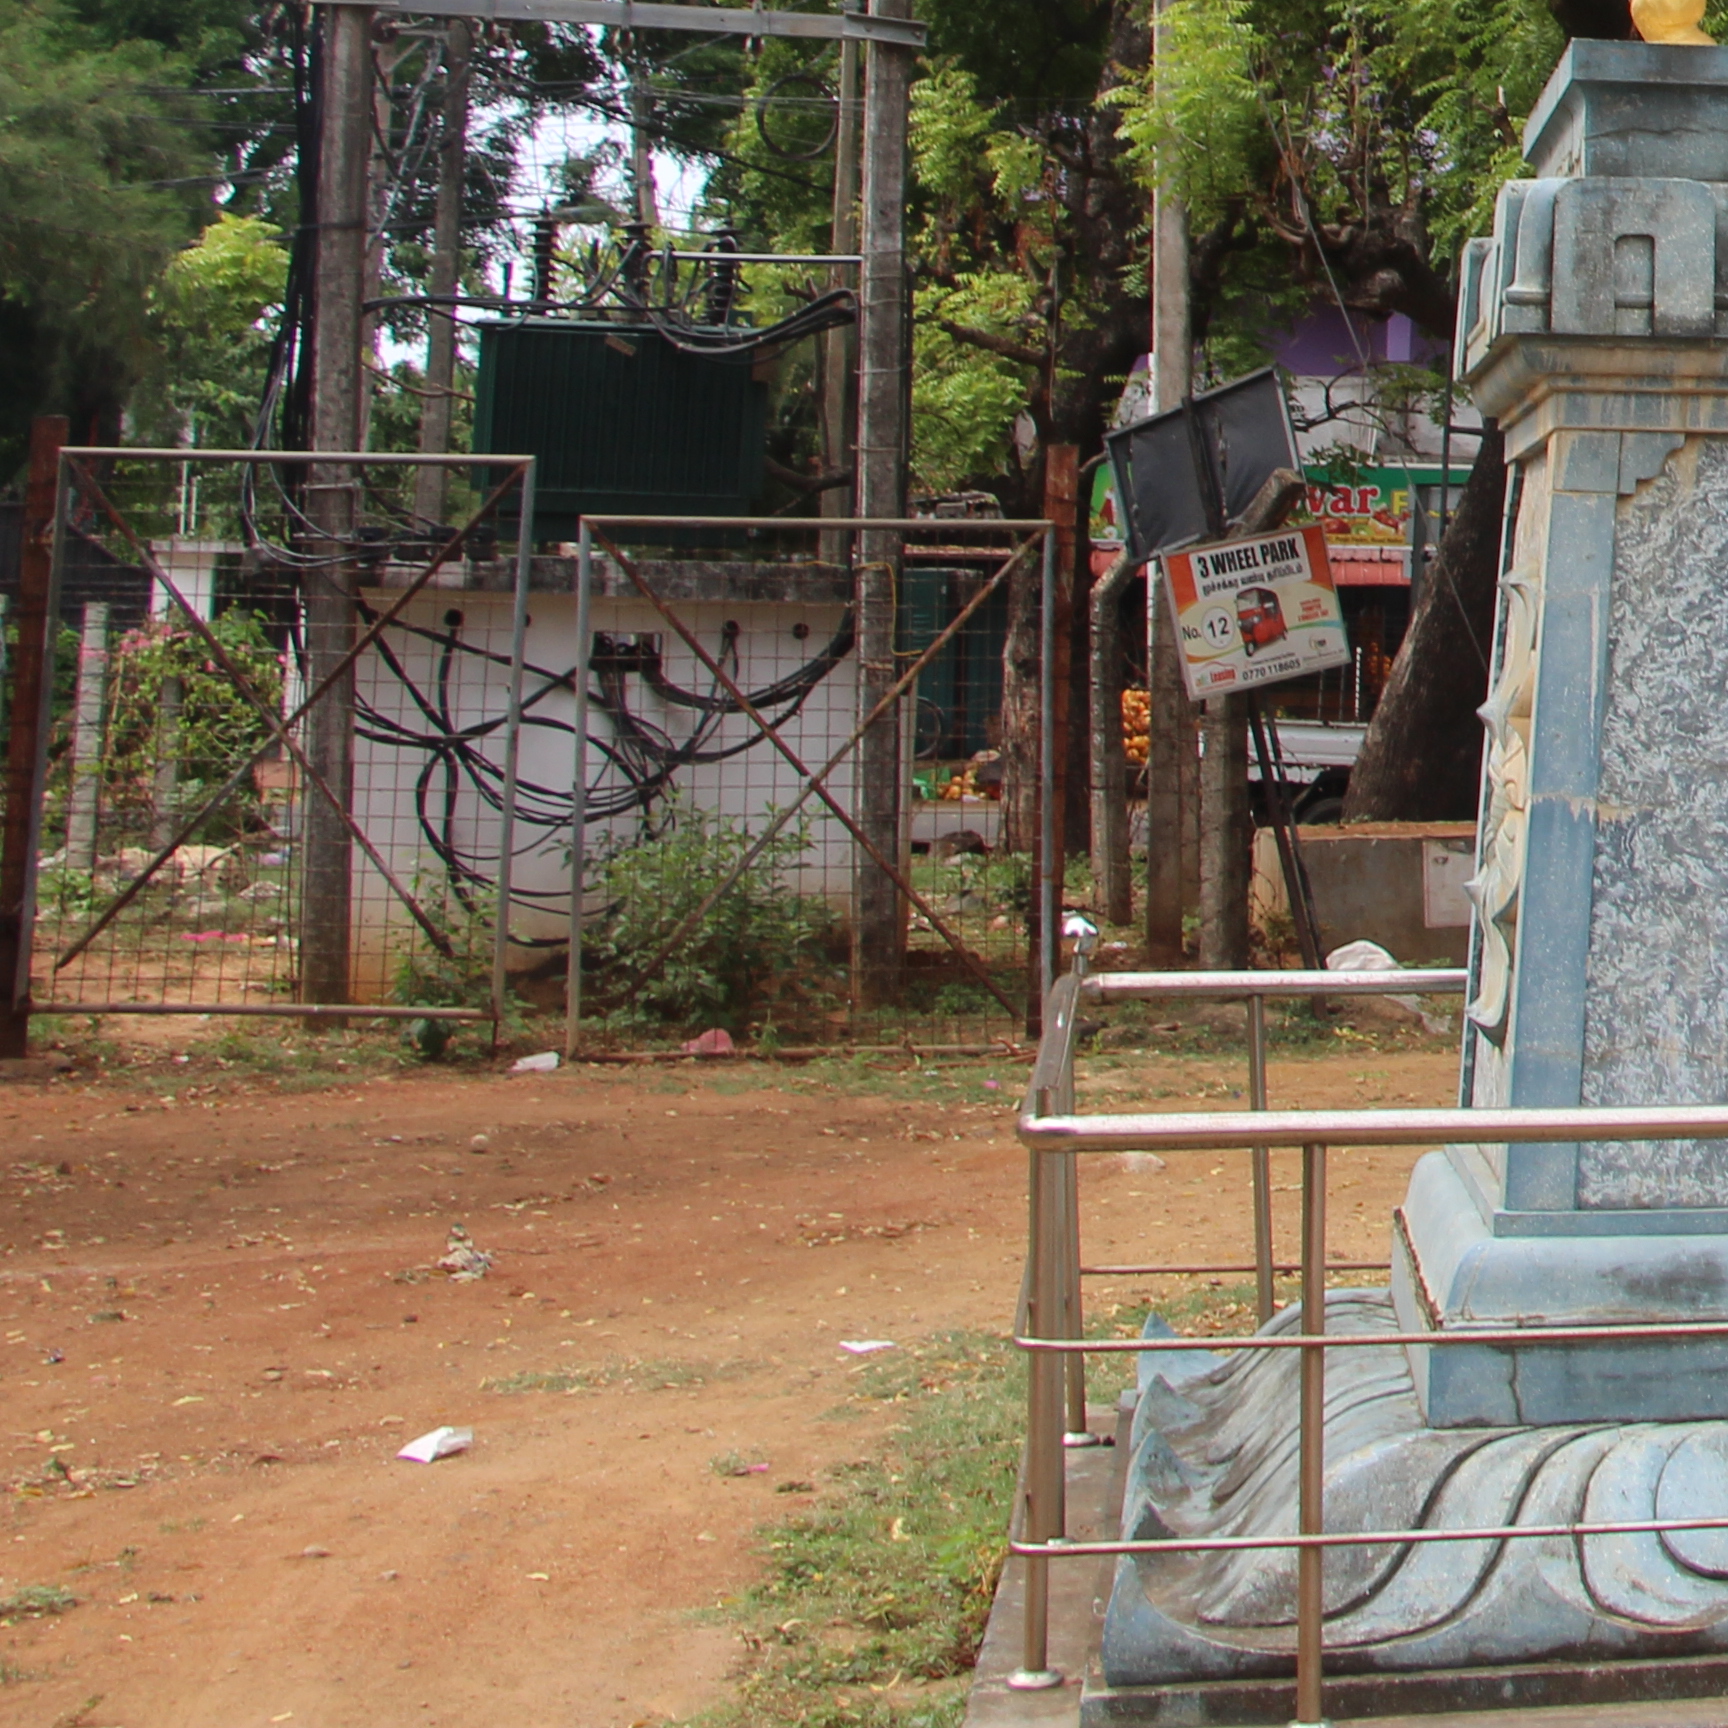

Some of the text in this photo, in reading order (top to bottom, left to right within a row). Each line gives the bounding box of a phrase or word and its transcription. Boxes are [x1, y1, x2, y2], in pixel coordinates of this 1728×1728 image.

[1197, 537, 1300, 578] 3 WHEEL PARK
[1207, 617, 1230, 639] 12
